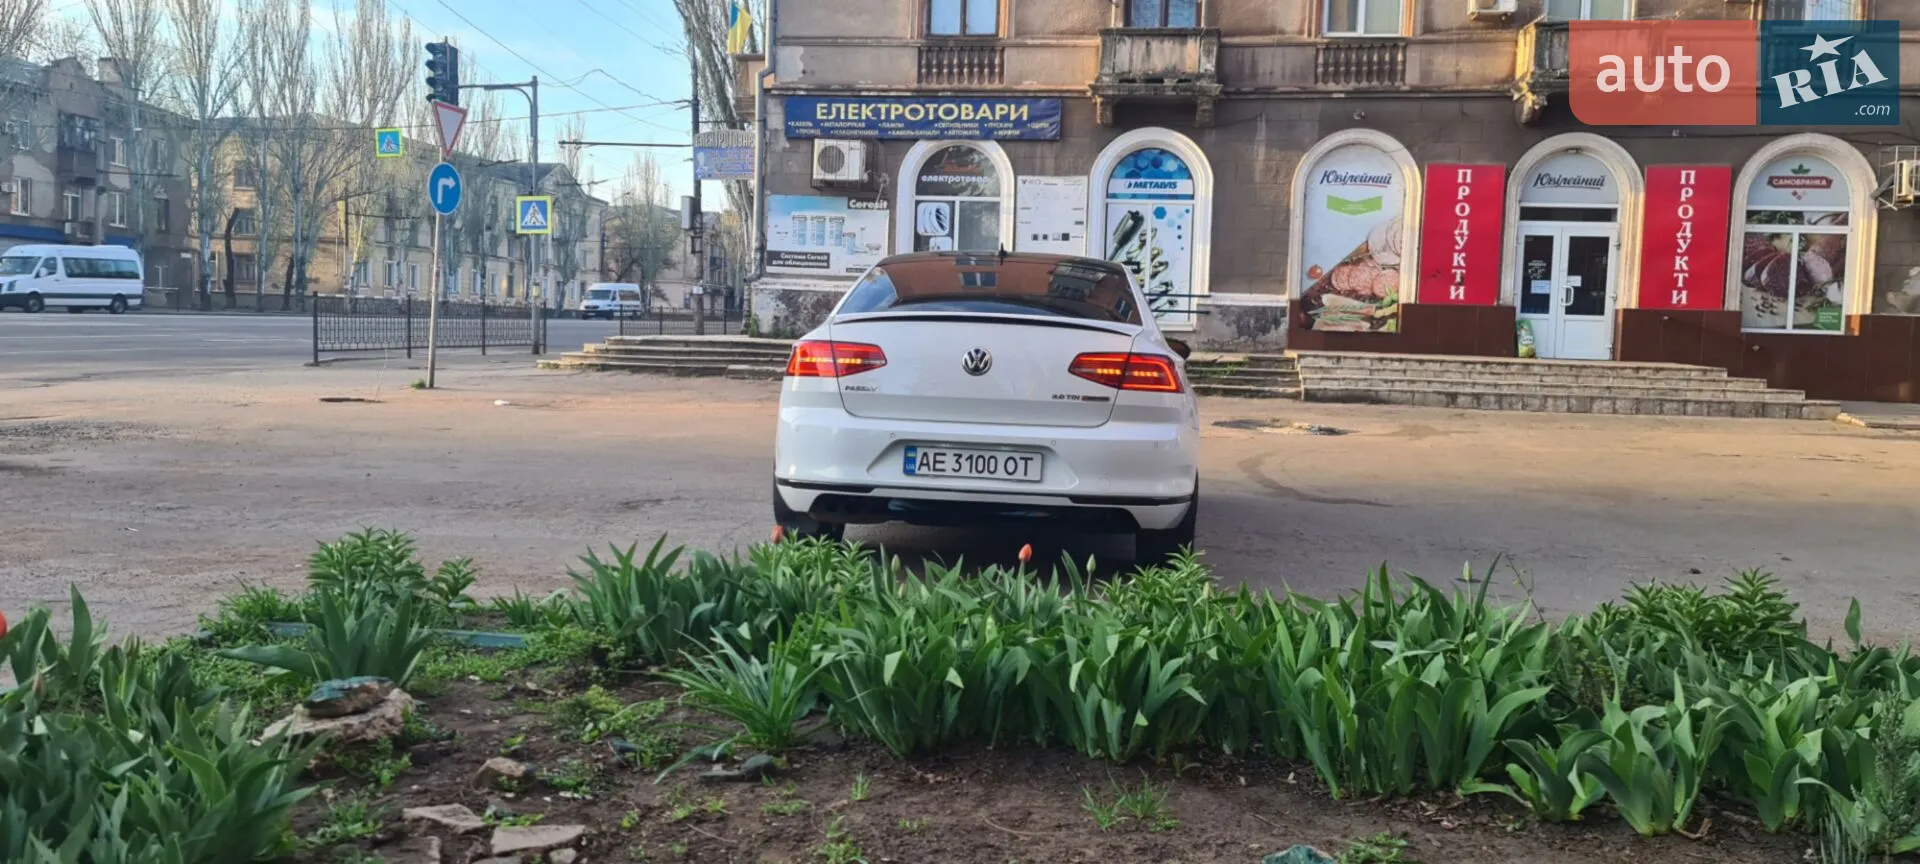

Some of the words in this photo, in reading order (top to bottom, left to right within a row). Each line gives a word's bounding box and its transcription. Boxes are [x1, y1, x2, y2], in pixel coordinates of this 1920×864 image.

[816, 103, 1029, 121] ЕЛЕКТРОТОВАРИ
[1319, 169, 1393, 186] Ювілейний
[1533, 172, 1606, 189] Ювілейний
[1772, 178, 1828, 187] САМОБРАНКА
[848, 199, 889, 209] Ceresit
[1449, 168, 1472, 300] ПРОДУКТИ
[1671, 169, 1696, 305] ПРОДУКТИ
[917, 451, 947, 473] AE
[951, 452, 998, 475] 3100
[1003, 456, 1034, 477] OT
